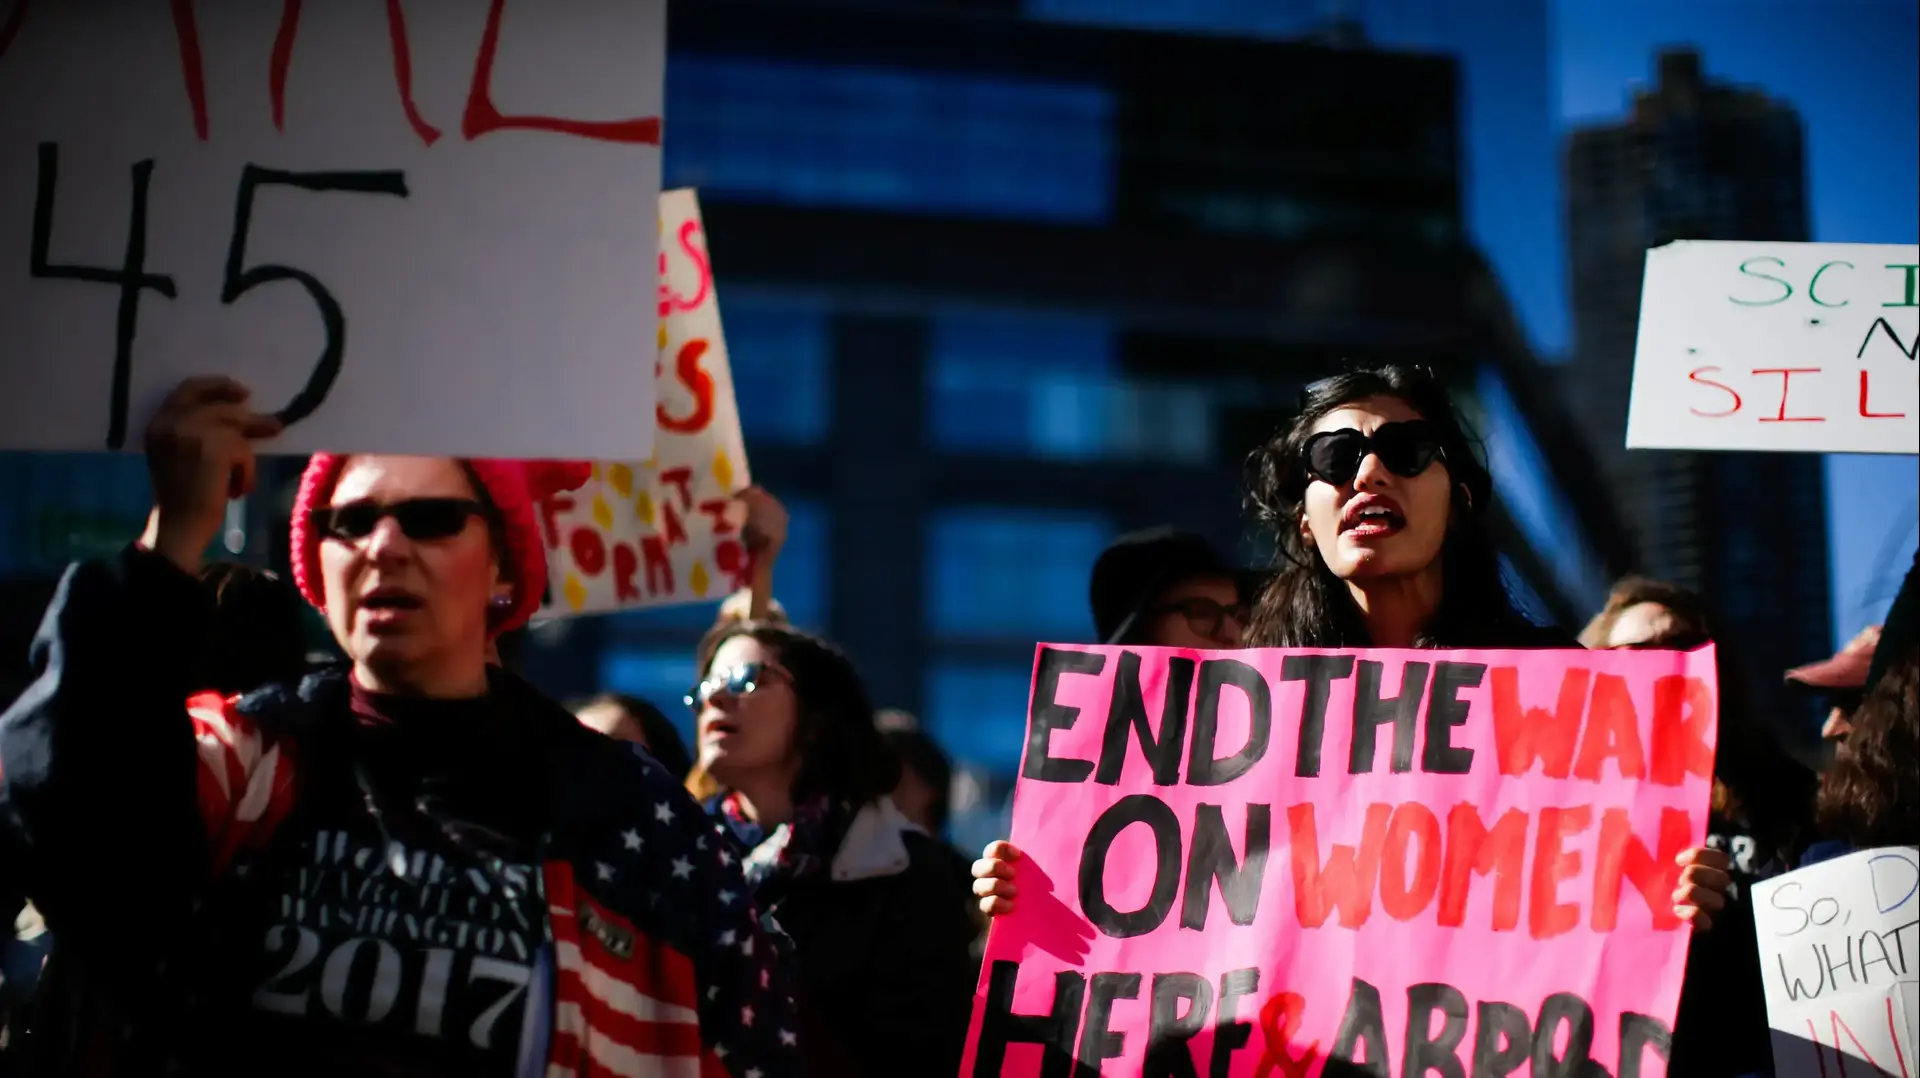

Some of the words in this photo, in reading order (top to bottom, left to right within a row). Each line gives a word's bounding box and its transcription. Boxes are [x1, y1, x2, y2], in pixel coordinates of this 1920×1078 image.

[30, 141, 409, 450] 45
[1688, 365, 1906, 421] SIL
[1022, 649, 1272, 787] END
[1281, 654, 1488, 778] THE
[1490, 666, 1715, 786] WAR
[1077, 794, 1271, 939] ON
[1287, 801, 1693, 941] WOMEN
[250, 922, 534, 1051] 2017
[973, 960, 1261, 1078] HERE
